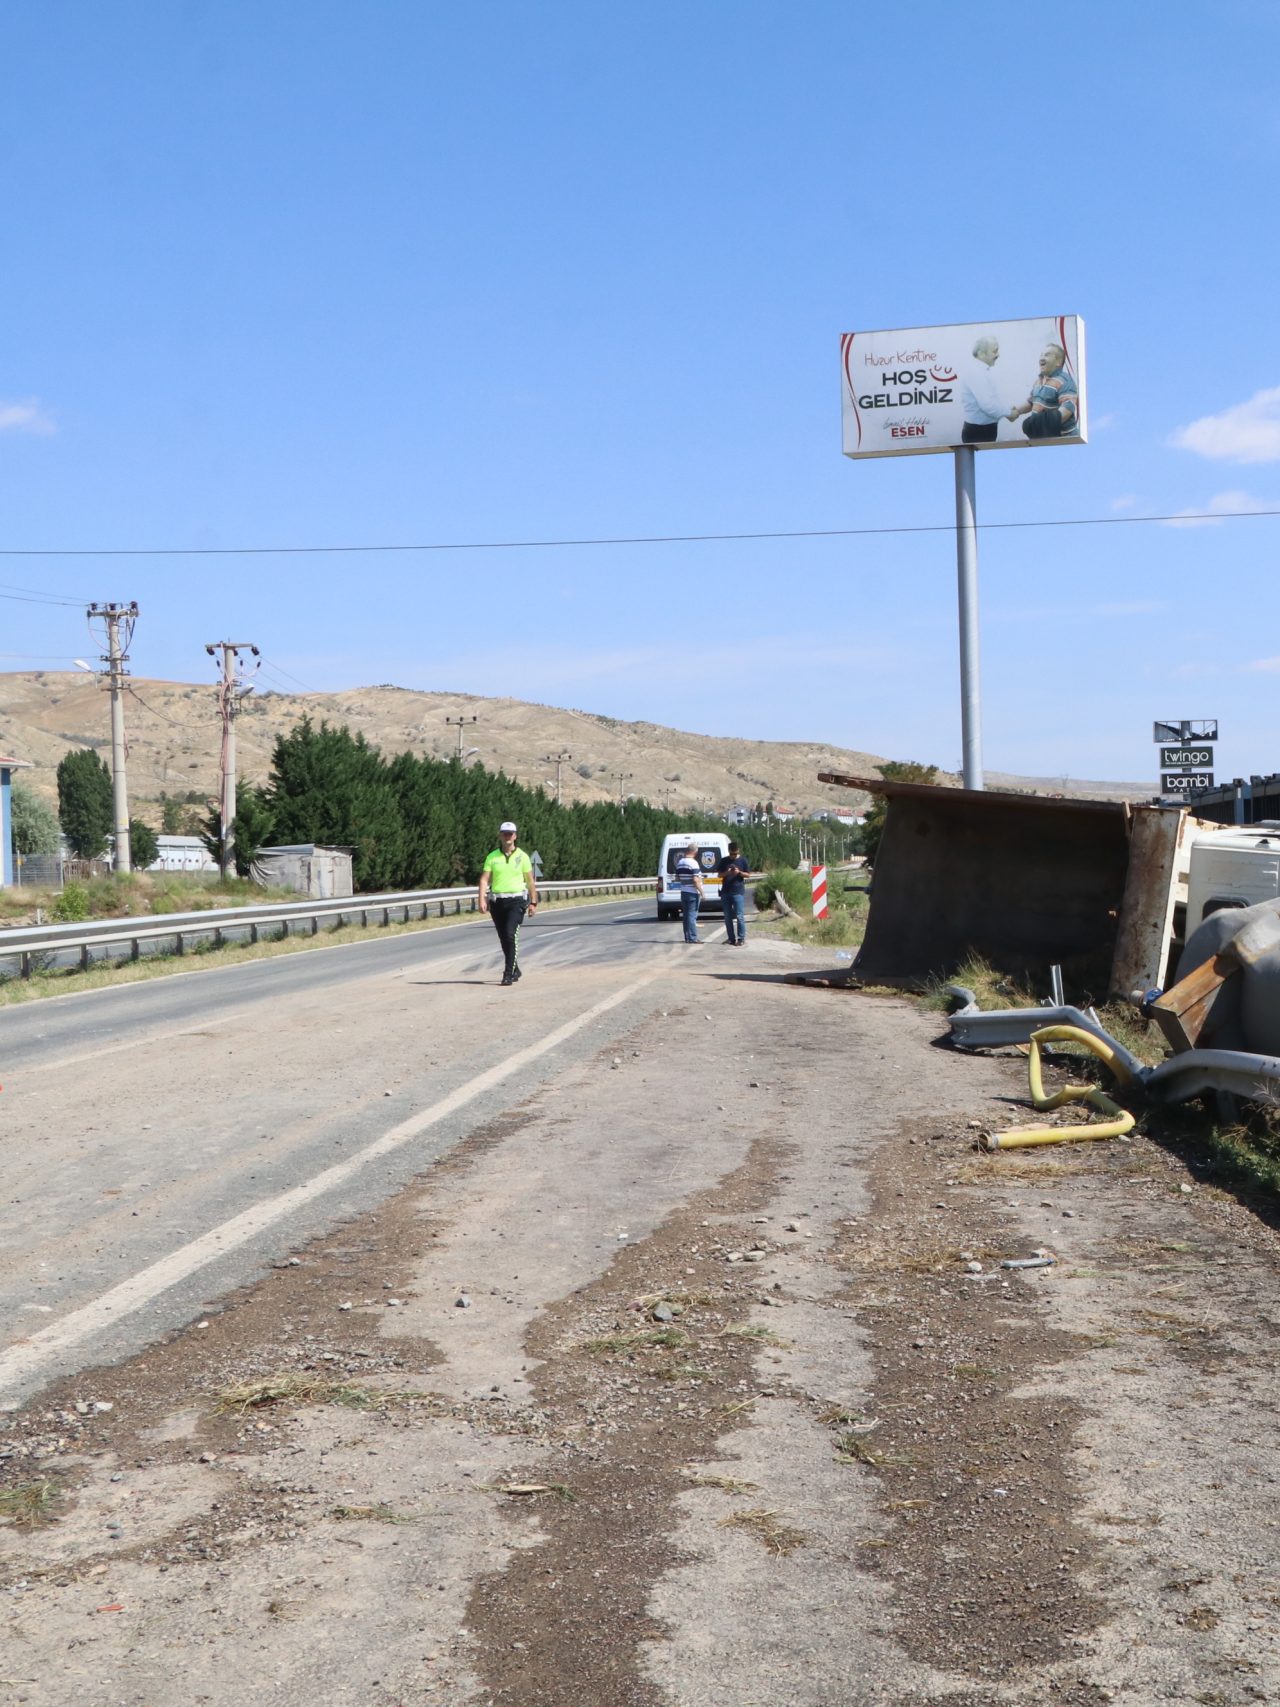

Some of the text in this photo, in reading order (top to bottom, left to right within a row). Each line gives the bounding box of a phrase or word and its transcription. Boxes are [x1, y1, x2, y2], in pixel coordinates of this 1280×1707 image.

[864, 352, 895, 366] Huzur
[882, 369, 927, 386] HOŞ
[858, 386, 953, 409] GELDİNİZ
[891, 425, 925, 437] ESEN
[1164, 750, 1209, 765] twingo
[1166, 774, 1209, 787] bambi
